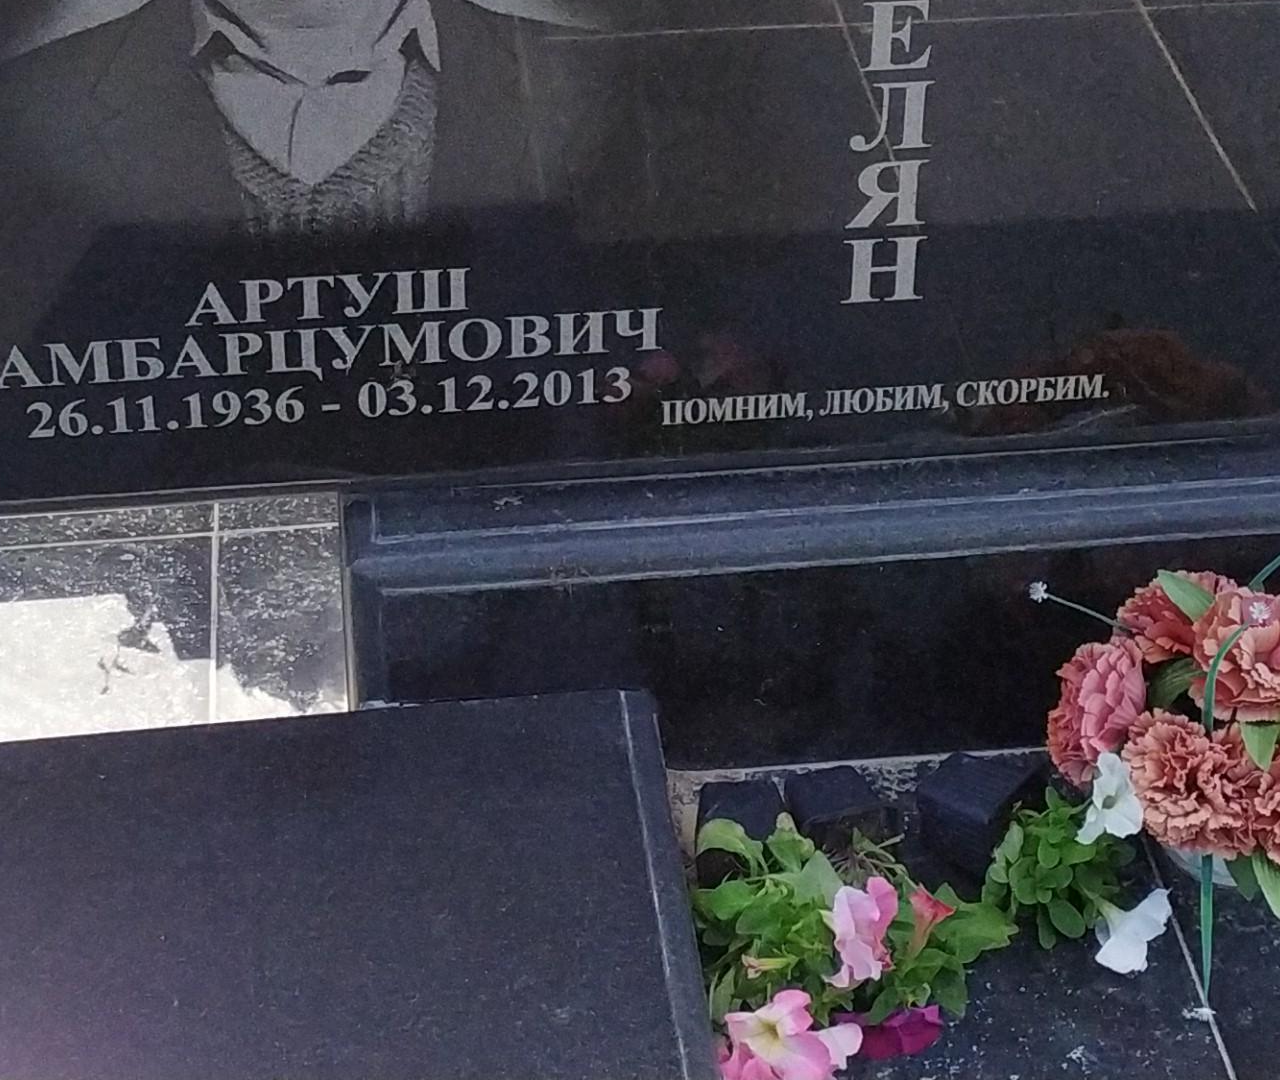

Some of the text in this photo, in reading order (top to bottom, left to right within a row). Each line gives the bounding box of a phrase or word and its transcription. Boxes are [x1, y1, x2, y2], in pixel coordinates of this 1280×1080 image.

[184, 267, 472, 327] АРТУШ
[26, 389, 306, 439] 26.11.1936
[357, 366, 632, 418] 03.12.2013
[661, 374, 1110, 426] ПОМНИМ, ЛЮБИМ, СКОРБИМ.
